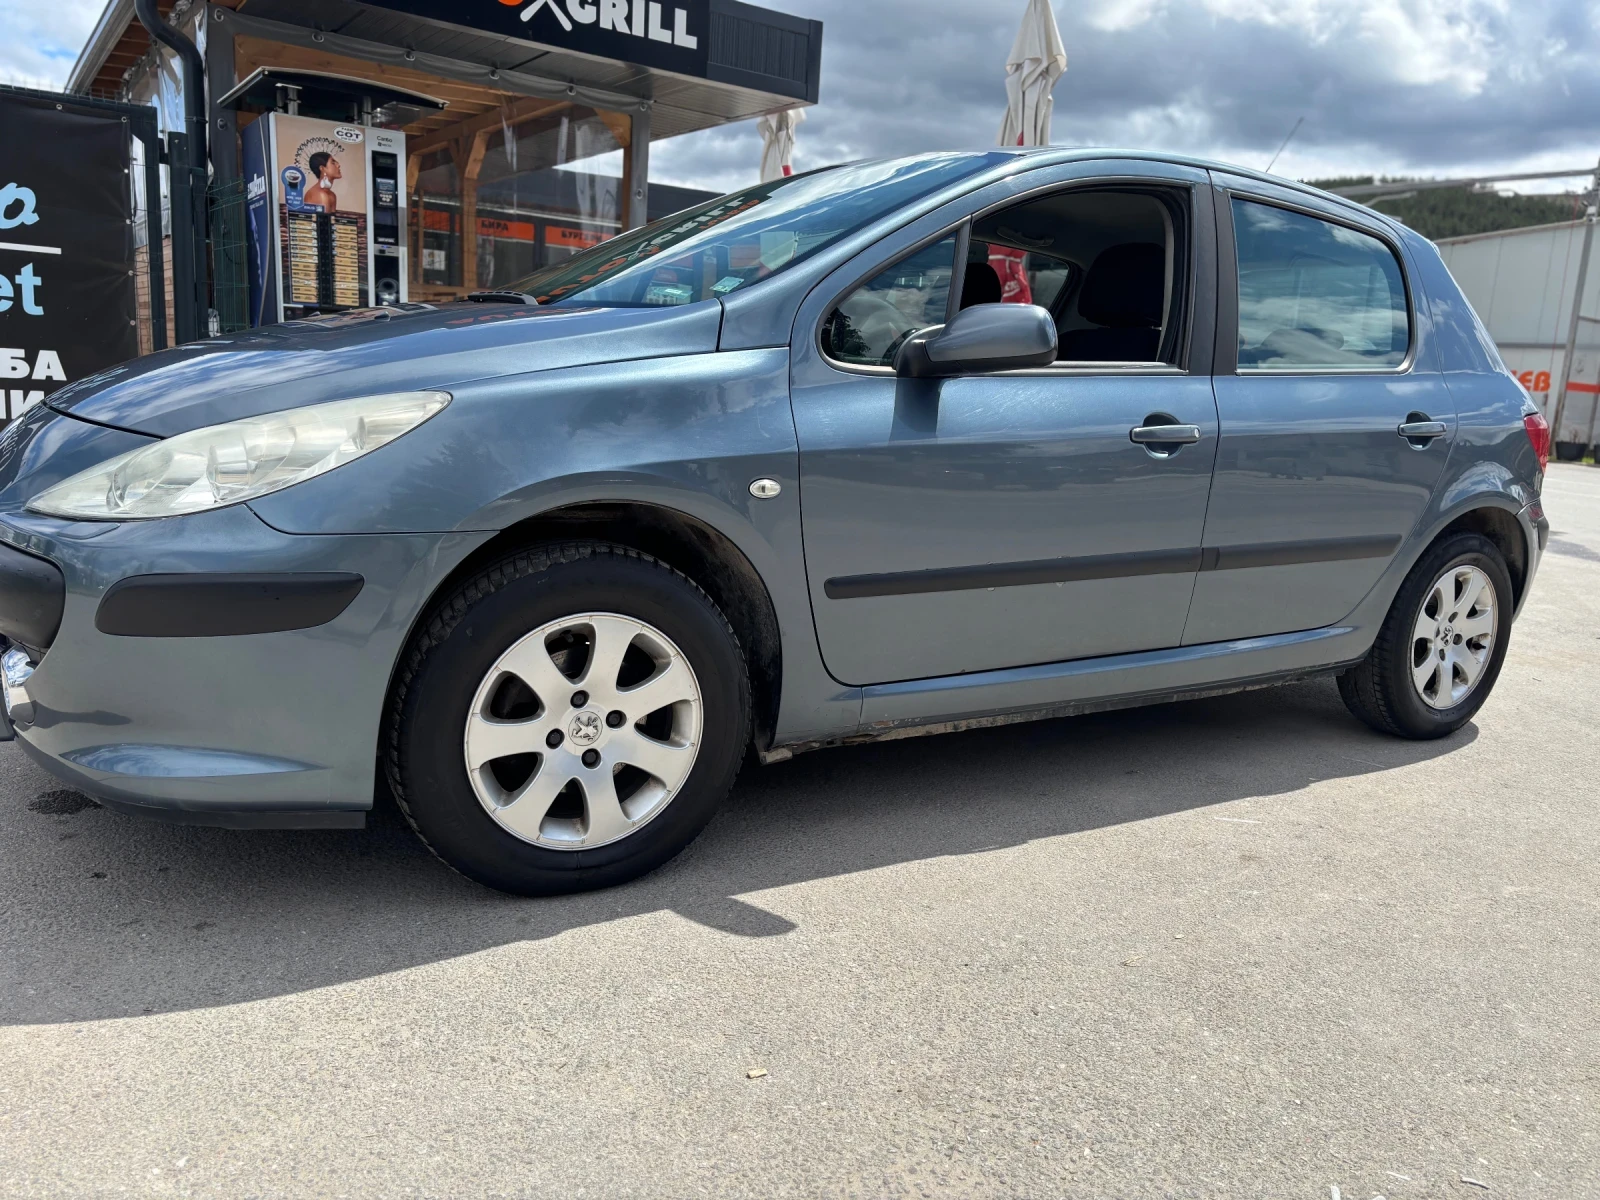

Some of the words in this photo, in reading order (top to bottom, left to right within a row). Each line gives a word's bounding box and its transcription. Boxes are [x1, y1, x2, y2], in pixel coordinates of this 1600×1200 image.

[566, 0, 697, 50] GRILL
[481, 219, 509, 231] БИРА
[1510, 369, 1551, 393] ЕВ
